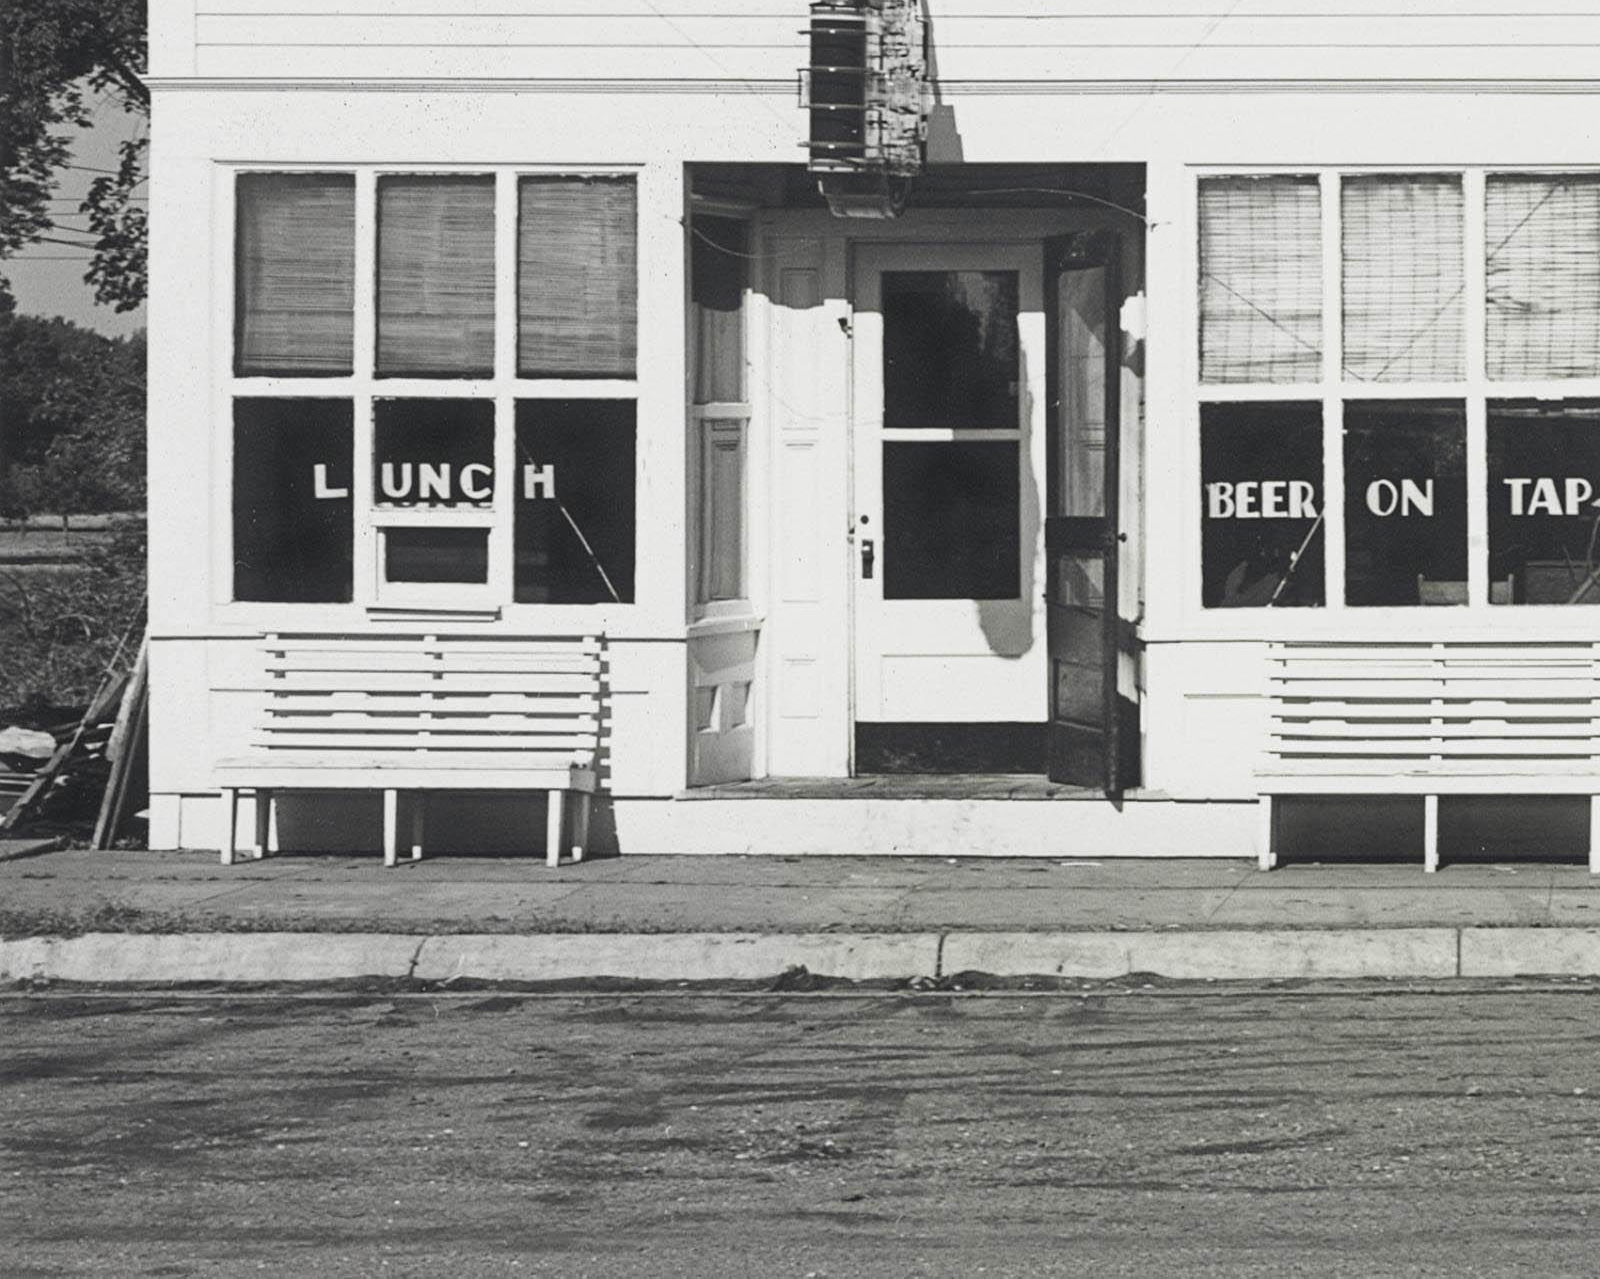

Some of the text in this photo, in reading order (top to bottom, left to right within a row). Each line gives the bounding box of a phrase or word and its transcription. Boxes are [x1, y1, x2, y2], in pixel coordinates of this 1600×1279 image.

[313, 462, 555, 499] LUNCH
[1207, 477, 1592, 519] BEER ON TAP
